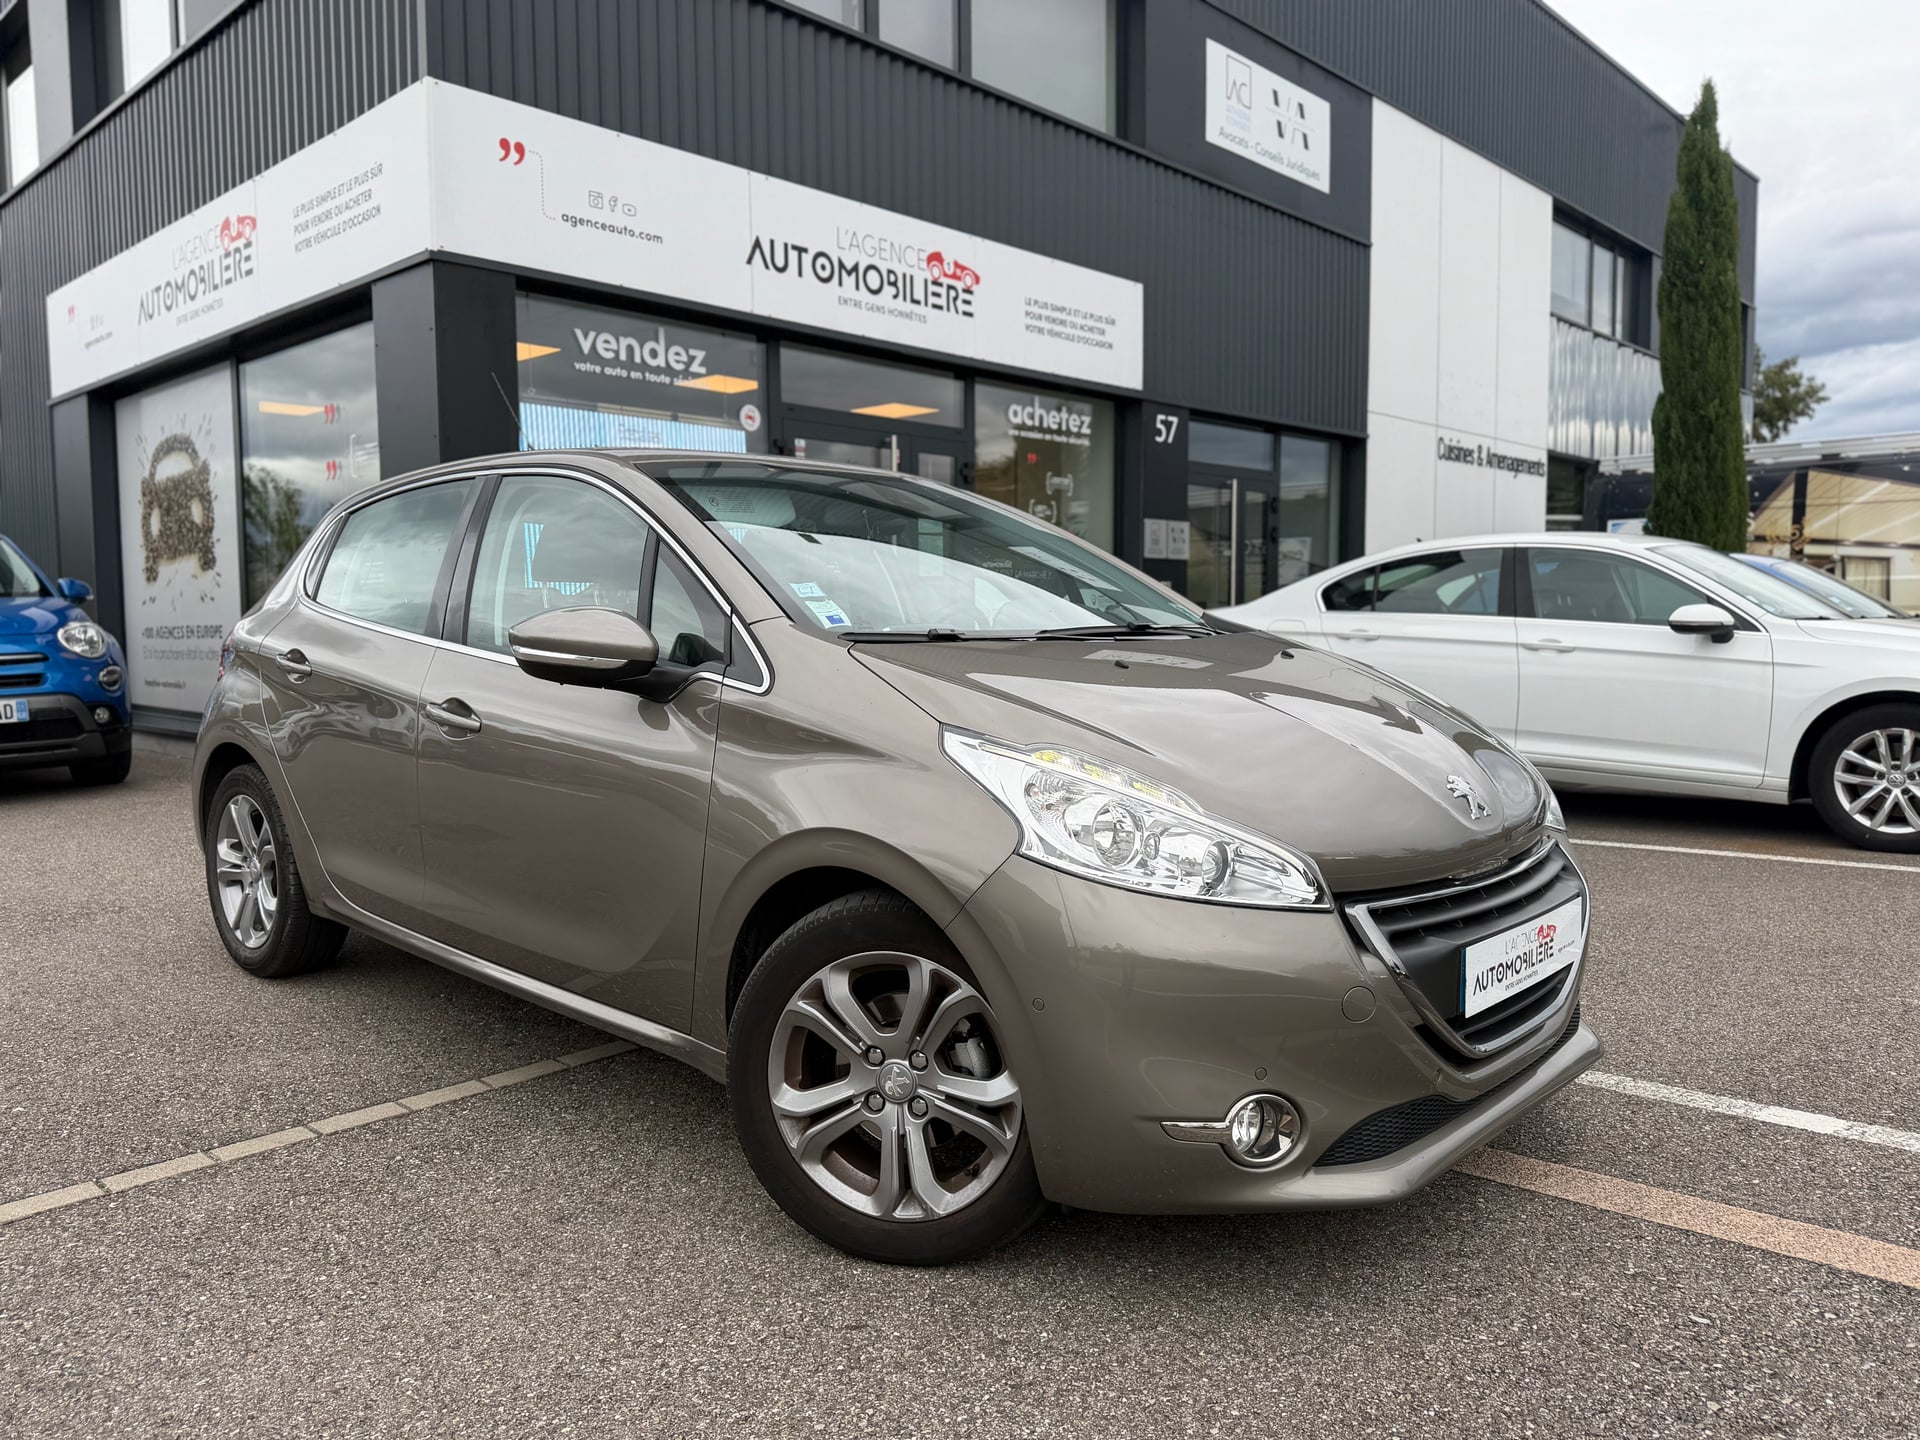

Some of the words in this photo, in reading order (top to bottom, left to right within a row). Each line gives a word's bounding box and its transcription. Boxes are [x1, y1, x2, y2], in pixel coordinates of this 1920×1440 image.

[1218, 126, 1249, 149] Avocats
[1255, 142, 1284, 166] Conseils
[293, 205, 300, 218] LE
[300, 198, 314, 214] PLUS
[315, 186, 336, 208] SIMPLE
[338, 182, 345, 196] ET
[346, 178, 353, 192] LE
[353, 170, 369, 187] PLUS
[294, 219, 310, 236] POUR
[311, 207, 333, 229] VENDRE
[334, 202, 344, 217] OU
[344, 188, 372, 213] ACHETER
[295, 236, 312, 253] VOTRE
[342, 202, 381, 233] D'OCCASION
[561, 213, 663, 244] agenceauto.com
[836, 226, 927, 271] L'AGENCE
[838, 296, 862, 310] ENTRE
[865, 301, 886, 315] GENS
[1024, 296, 1032, 307] LE
[1033, 298, 1048, 310] PLUS
[1050, 303, 1072, 317] SIMPLE
[1089, 312, 1103, 324] PLUS
[1025, 310, 1042, 322] POUR
[1044, 314, 1068, 329] VENDRE
[1025, 323, 1045, 336] VOTRE
[573, 326, 707, 374] vendez
[574, 361, 601, 374] votre
[604, 366, 628, 378] auto
[630, 371, 643, 381] en
[645, 371, 671, 385] toute
[1008, 395, 1092, 435] achetez
[1154, 414, 1179, 444] 57
[1437, 436, 1475, 465] Cuisines
[1477, 444, 1484, 467] &
